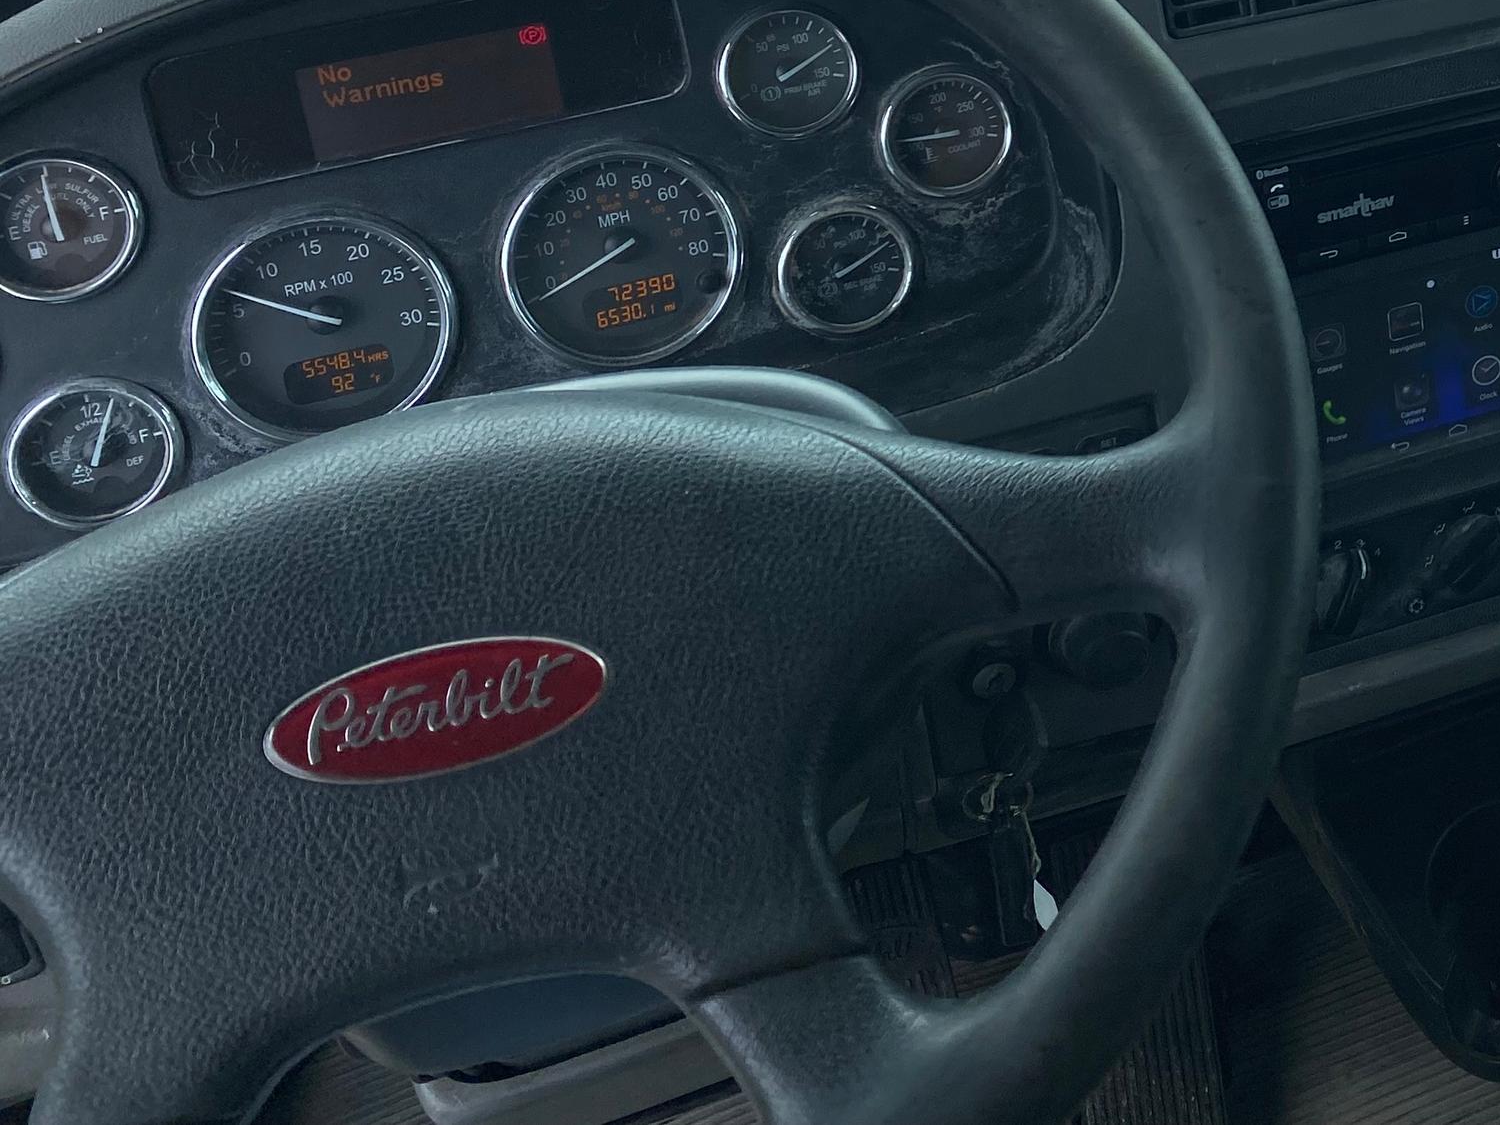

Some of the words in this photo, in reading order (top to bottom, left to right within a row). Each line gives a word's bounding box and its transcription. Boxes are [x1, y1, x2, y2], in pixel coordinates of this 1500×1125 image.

[791, 32, 809, 44] 100
[755, 41, 769, 53] 50
[316, 64, 353, 86] No
[814, 66, 831, 78] 150
[322, 71, 445, 108] Warnings
[928, 91, 948, 105] 200
[956, 100, 975, 114] 250
[595, 172, 618, 189] 40
[631, 173, 653, 190] 50
[10, 193, 33, 221] ULTRA
[36, 183, 58, 195] LW
[64, 182, 100, 204] SULFUR
[565, 186, 587, 204] 30
[657, 185, 679, 202] 60
[75, 197, 96, 219] ONLY
[99, 205, 110, 221] F
[678, 207, 701, 225] 70
[544, 210, 567, 227] 20
[597, 209, 632, 229] MPH
[8, 225, 22, 241] E
[83, 233, 108, 246] FUEL
[849, 228, 867, 241] 100
[297, 238, 323, 258] 15
[346, 243, 371, 262] 20
[533, 240, 555, 259] 10
[687, 238, 710, 257] 80
[255, 262, 279, 280] 10
[380, 265, 406, 286] 25
[870, 261, 887, 273] 150
[283, 277, 317, 298] RPM
[319, 279, 328, 290] x
[330, 271, 355, 287] 100
[544, 275, 557, 290] 0
[606, 272, 677, 303] 72390
[232, 303, 246, 319] 5
[399, 307, 424, 327] 30
[595, 302, 656, 330] 6530.1
[664, 300, 677, 313] mi
[1473, 322, 1494, 334] Audio
[1389, 340, 1427, 356] Navigation
[239, 351, 252, 368] 0
[301, 349, 367, 380] 5548.4
[367, 349, 390, 364] HRS
[1316, 362, 1344, 376] Gauges
[331, 372, 355, 395] 92
[1479, 390, 1499, 402] Clock
[79, 402, 103, 419] 1/2
[1400, 406, 1428, 420] Camera
[1403, 415, 1425, 427] Views
[138, 428, 149, 444] F
[1326, 432, 1349, 444] Phone
[49, 450, 62, 466] E
[125, 455, 145, 468] DEF
[1334, 539, 1343, 551] 2
[306, 652, 575, 767] Peterbilt
